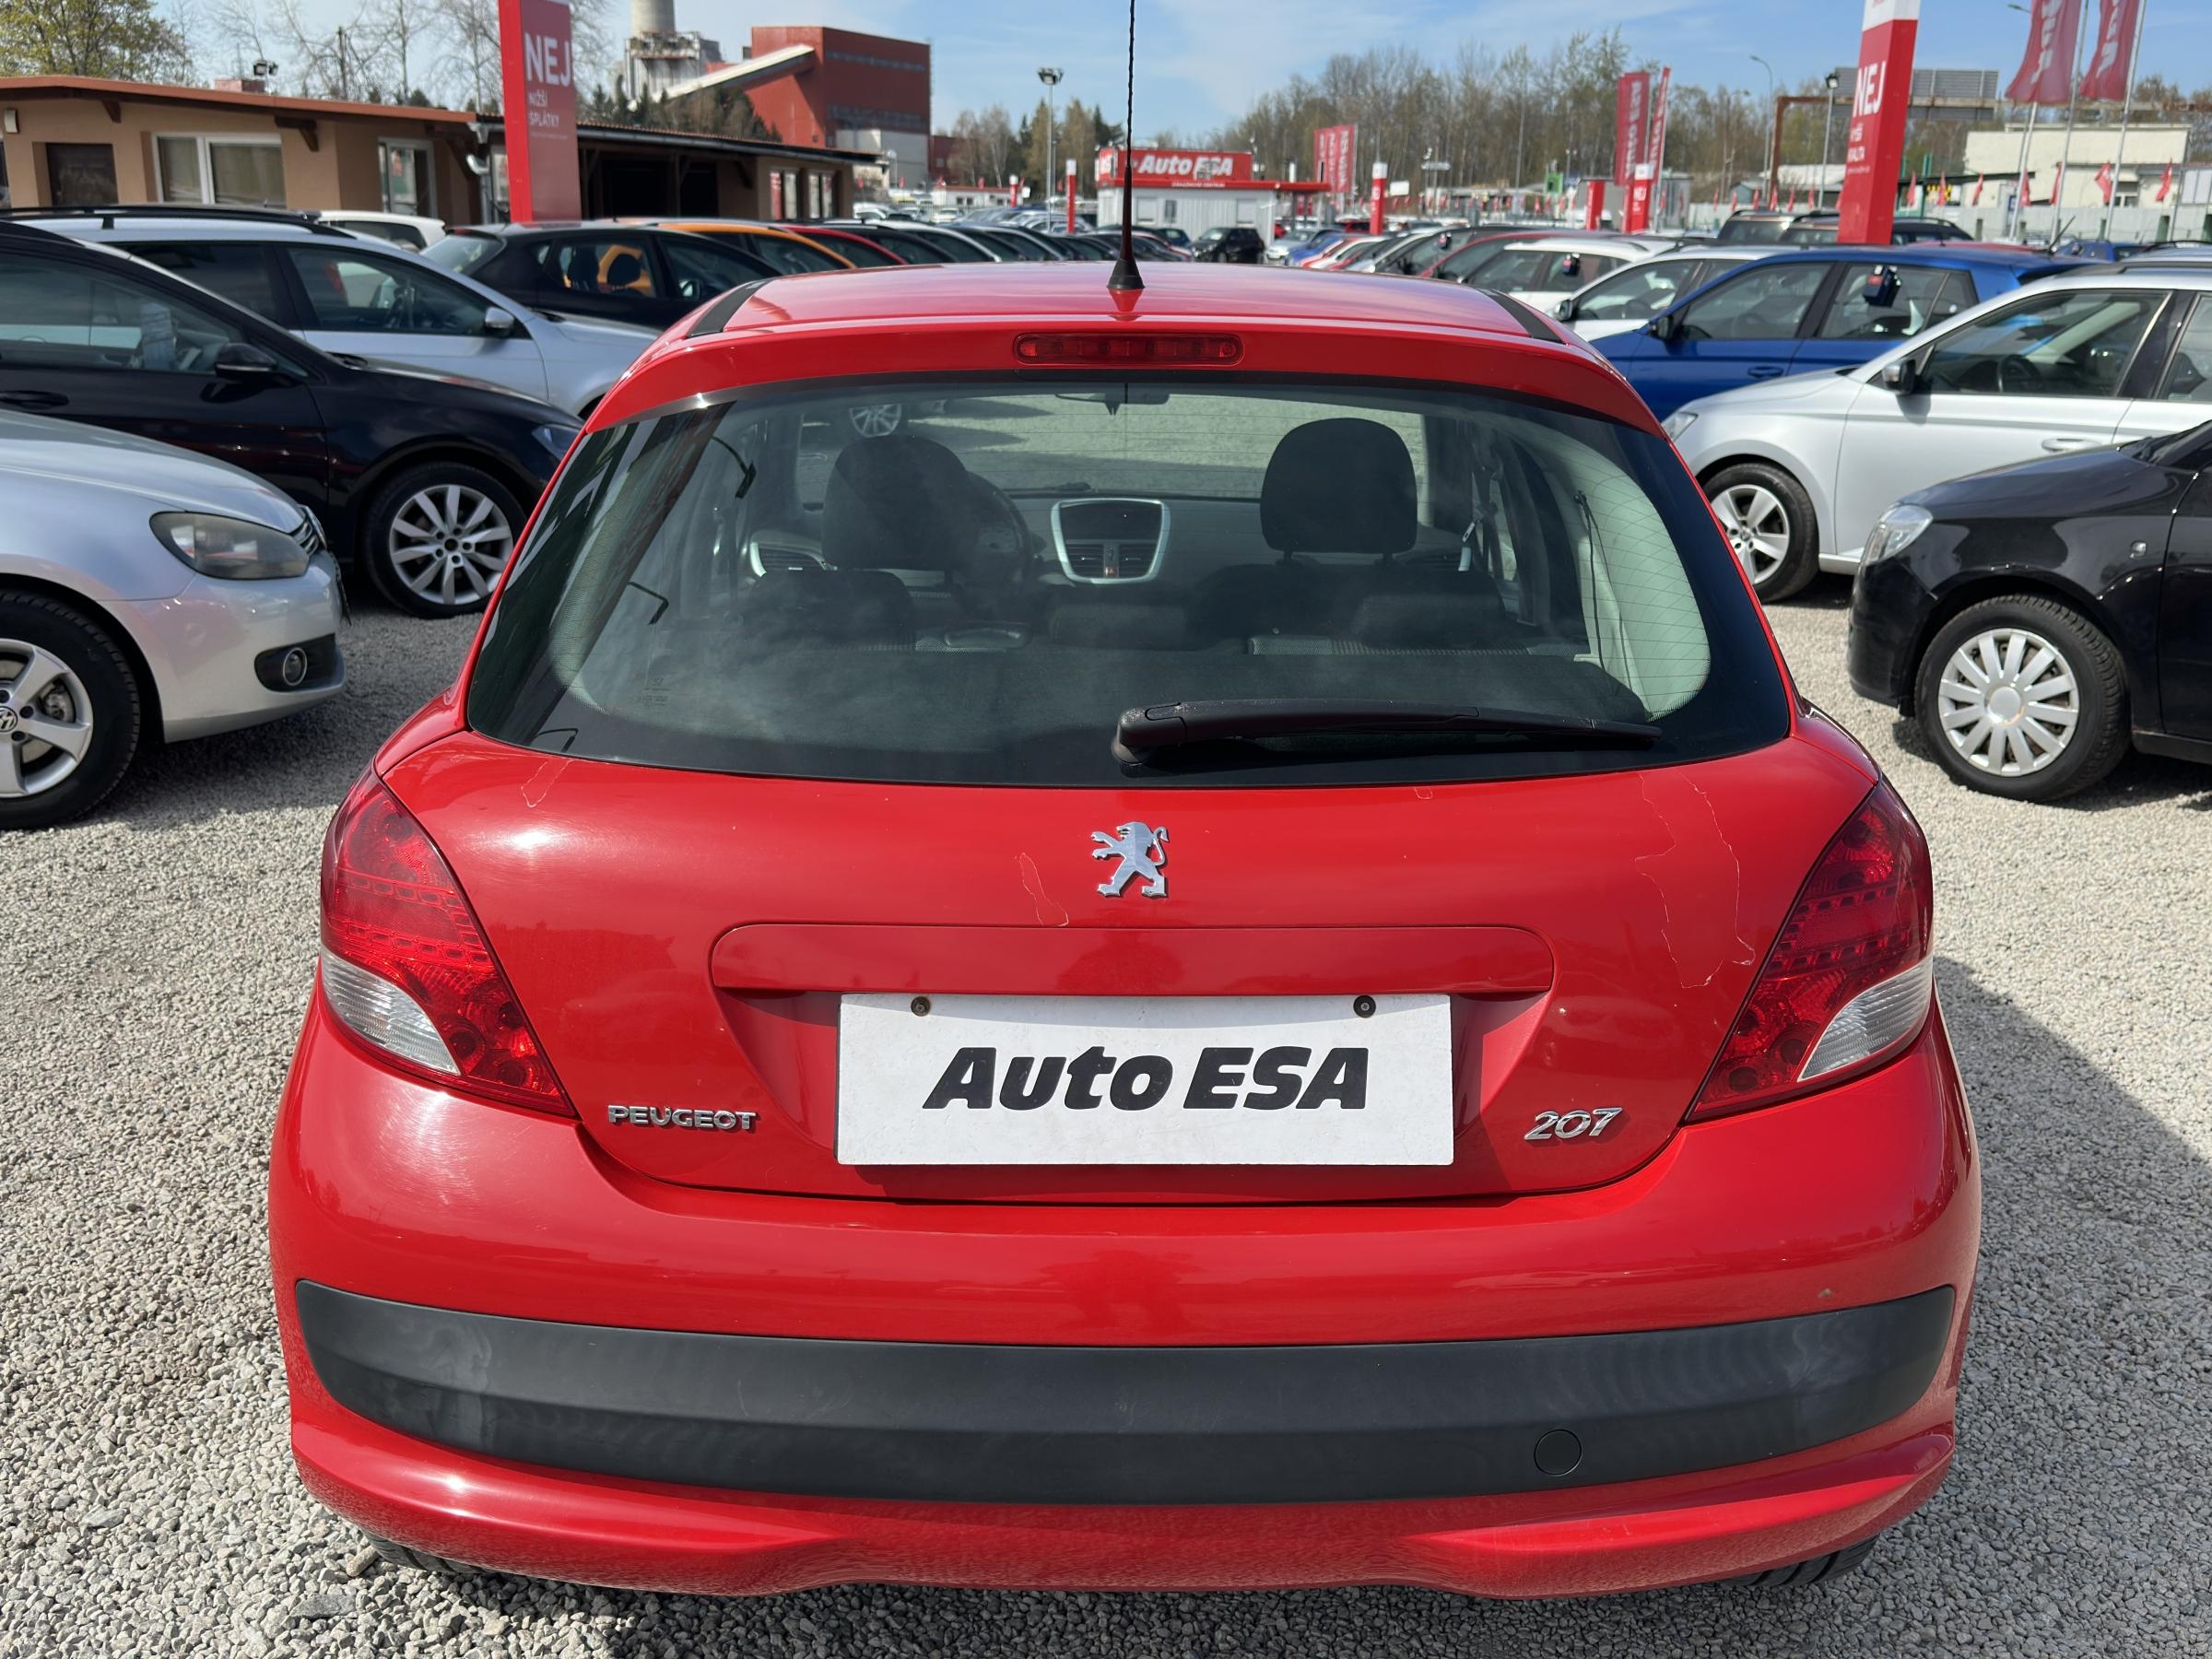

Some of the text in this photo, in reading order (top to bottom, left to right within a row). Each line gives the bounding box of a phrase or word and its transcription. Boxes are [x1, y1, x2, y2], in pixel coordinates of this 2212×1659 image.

[524, 32, 571, 88] NEJ
[1853, 61, 1887, 117] NEJ
[1137, 155, 1193, 175] Auto
[922, 1046, 1369, 1111] Auto ESA
[607, 1104, 757, 1130] PEUGEOT
[1524, 1107, 1622, 1140] 207
